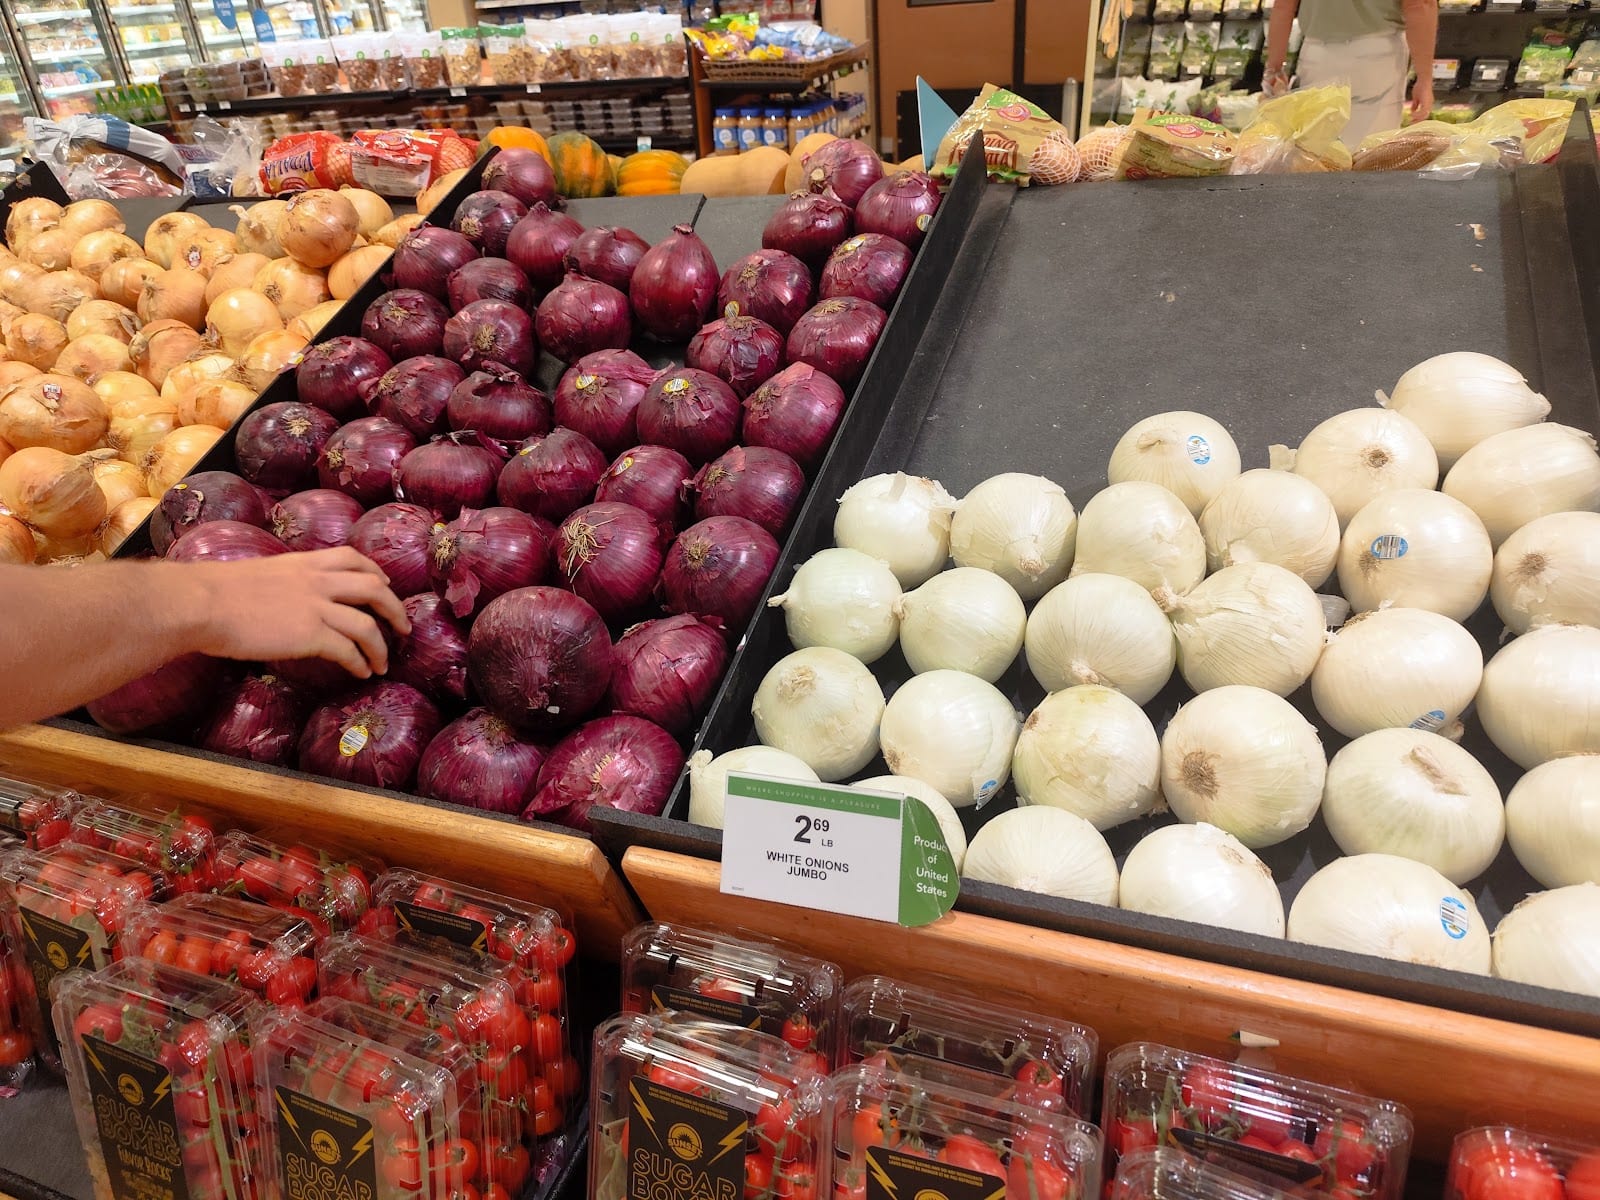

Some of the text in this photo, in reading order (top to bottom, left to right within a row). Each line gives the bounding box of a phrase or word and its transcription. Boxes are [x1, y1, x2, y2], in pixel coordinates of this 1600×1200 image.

[746, 785, 771, 794] WHERE
[775, 790, 816, 801] SHOPPING
[839, 799, 881, 811] PLEASURE
[821, 838, 833, 847] LB
[914, 835, 947, 852] Produc
[766, 850, 849, 873] WHITE ONIONS
[927, 855, 937, 864] of
[787, 866, 827, 881] JUMBO
[916, 866, 949, 883] United
[916, 882, 947, 898] States
[97, 1094, 176, 1148] SUGAR
[98, 1113, 182, 1167] BOMBS
[668, 1131, 704, 1158] SUNSET
[286, 1152, 371, 1200] SUGAR
[633, 1148, 736, 1200] SUGAR
